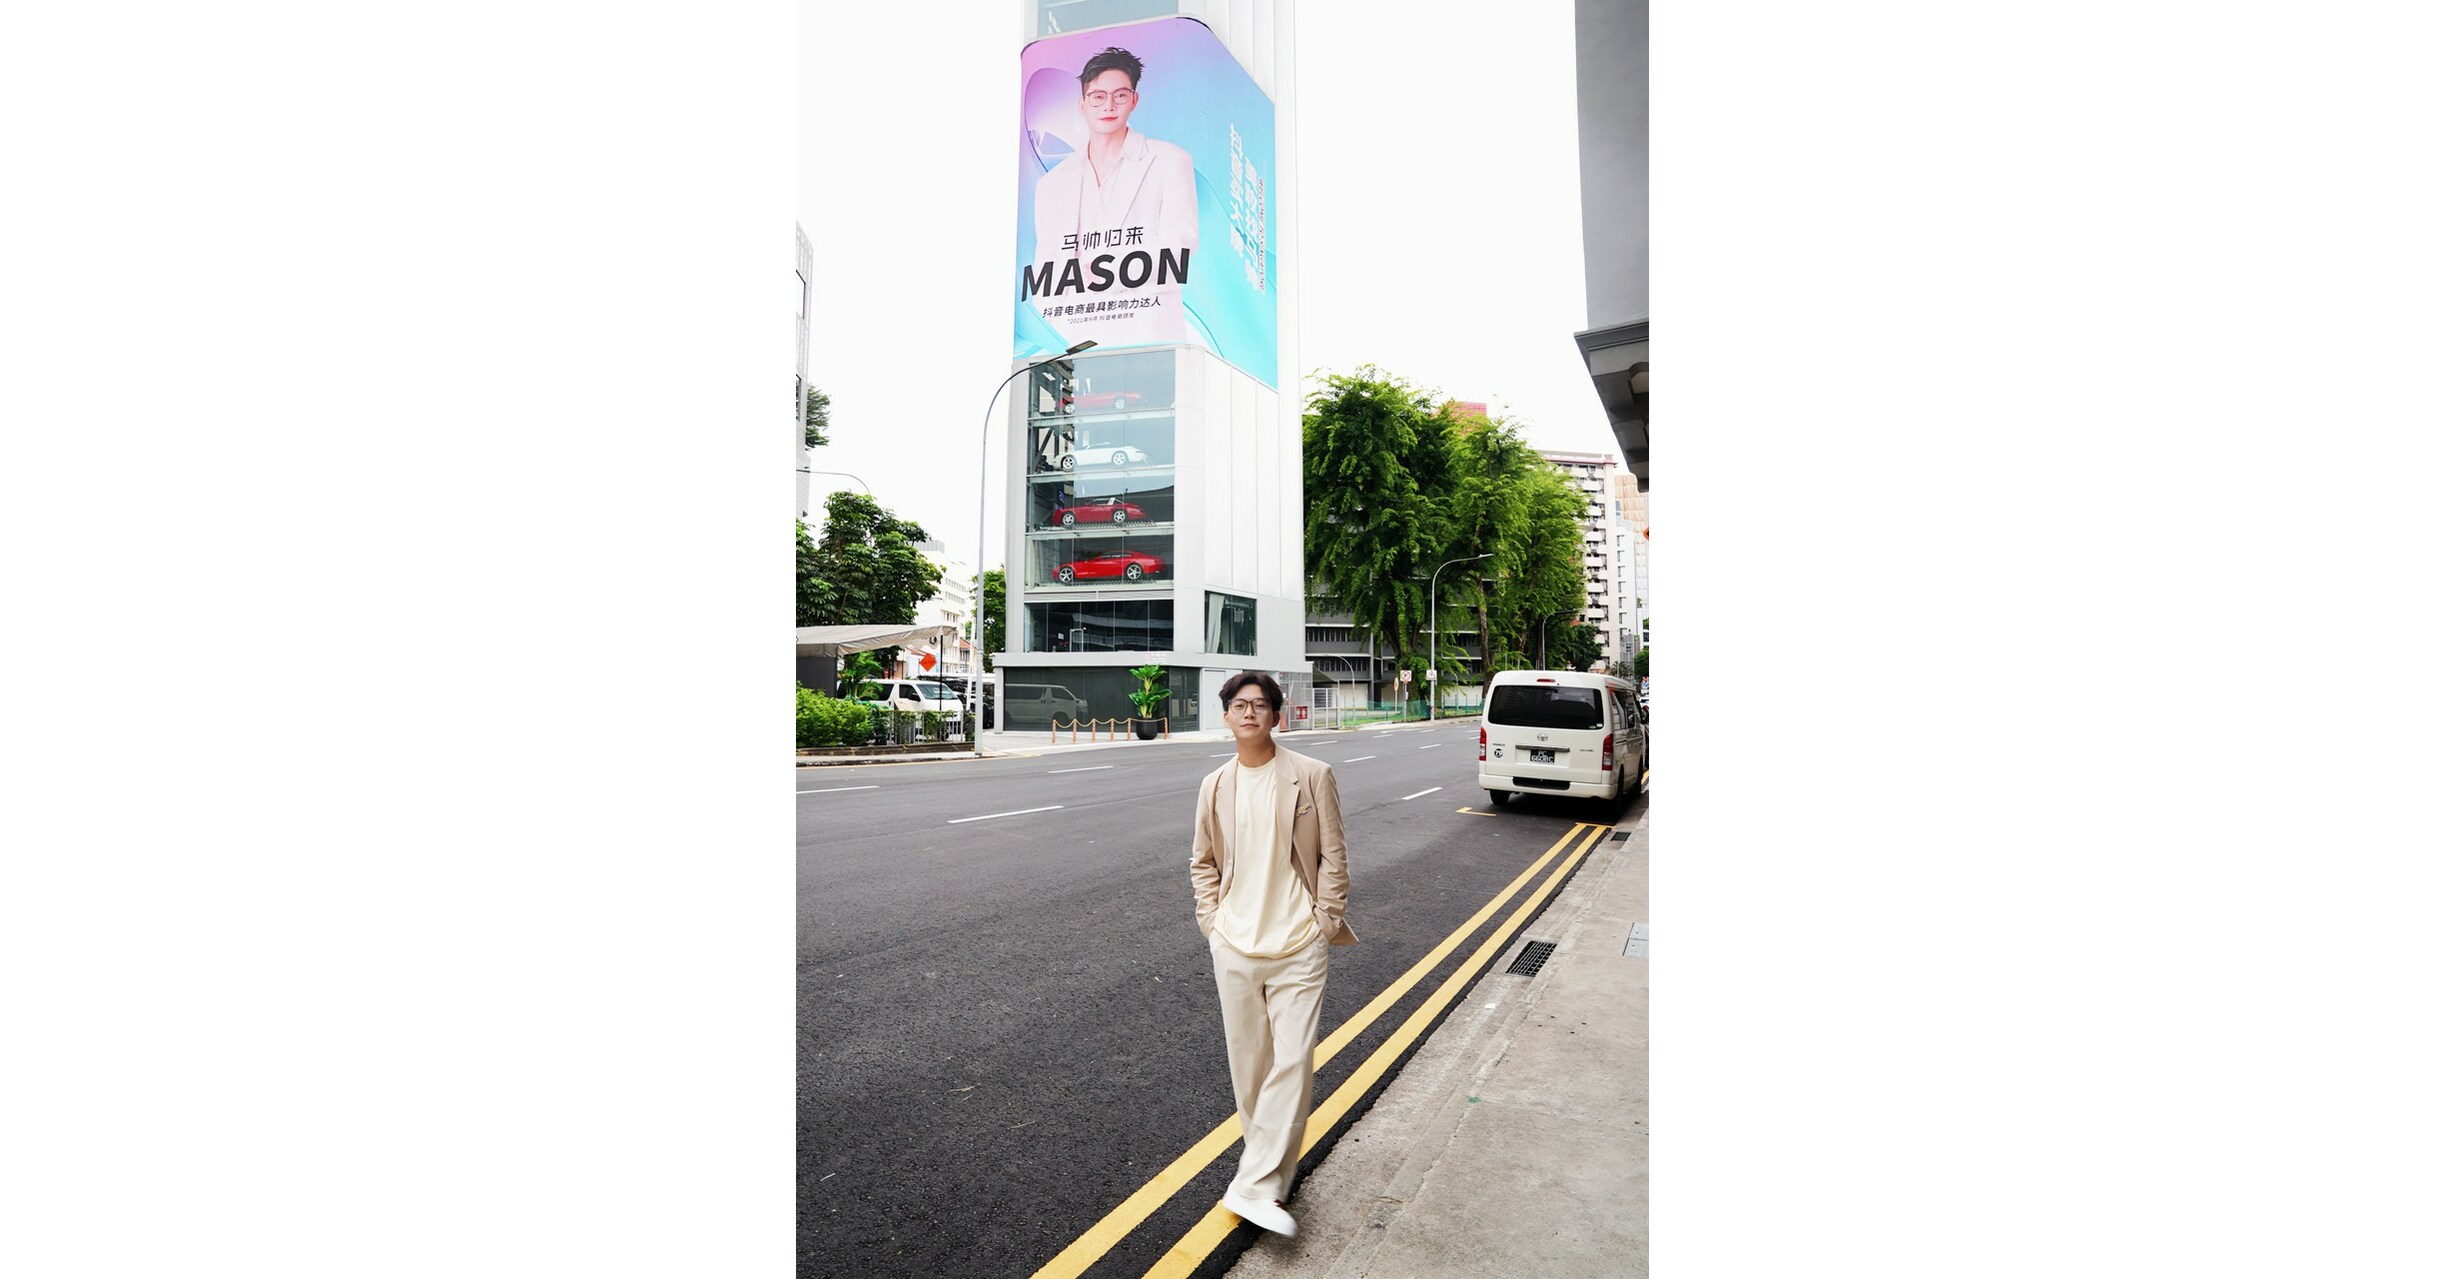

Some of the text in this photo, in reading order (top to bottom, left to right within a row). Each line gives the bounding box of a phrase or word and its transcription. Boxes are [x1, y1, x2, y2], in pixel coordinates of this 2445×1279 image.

[1062, 226, 1144, 252] 马帅归来
[1021, 248, 1190, 302] MASON
[1043, 296, 1161, 318] 抖音电商最具影响力达人
